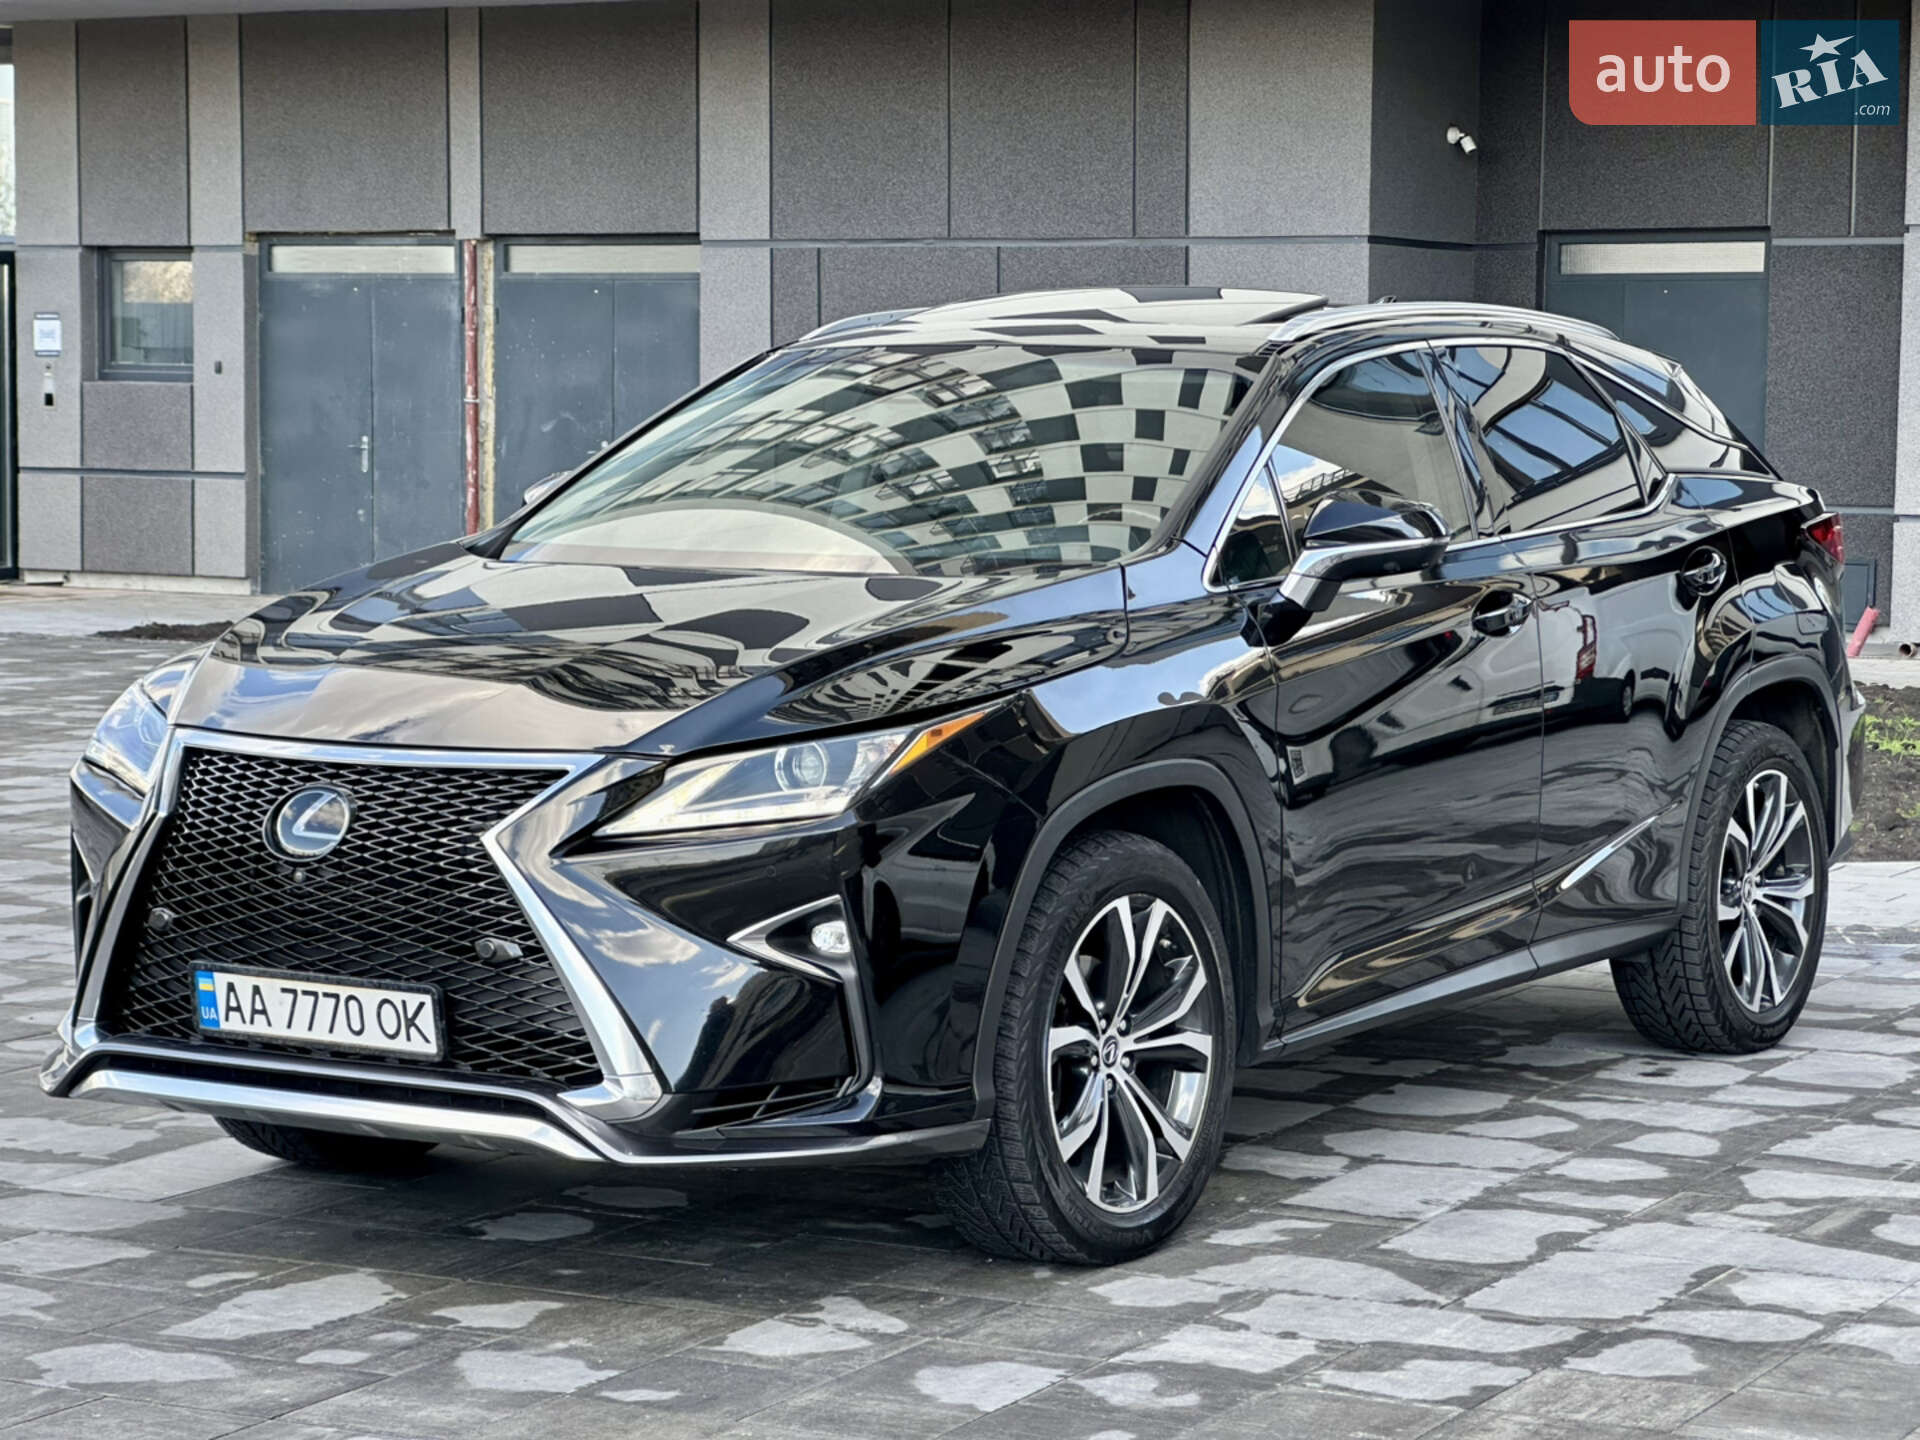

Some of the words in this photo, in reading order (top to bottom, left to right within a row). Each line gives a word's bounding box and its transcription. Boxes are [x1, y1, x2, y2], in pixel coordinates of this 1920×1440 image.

[201, 1006, 218, 1020] UA
[224, 981, 272, 1028] AA
[280, 987, 365, 1037] 7770
[376, 998, 431, 1044] OK
